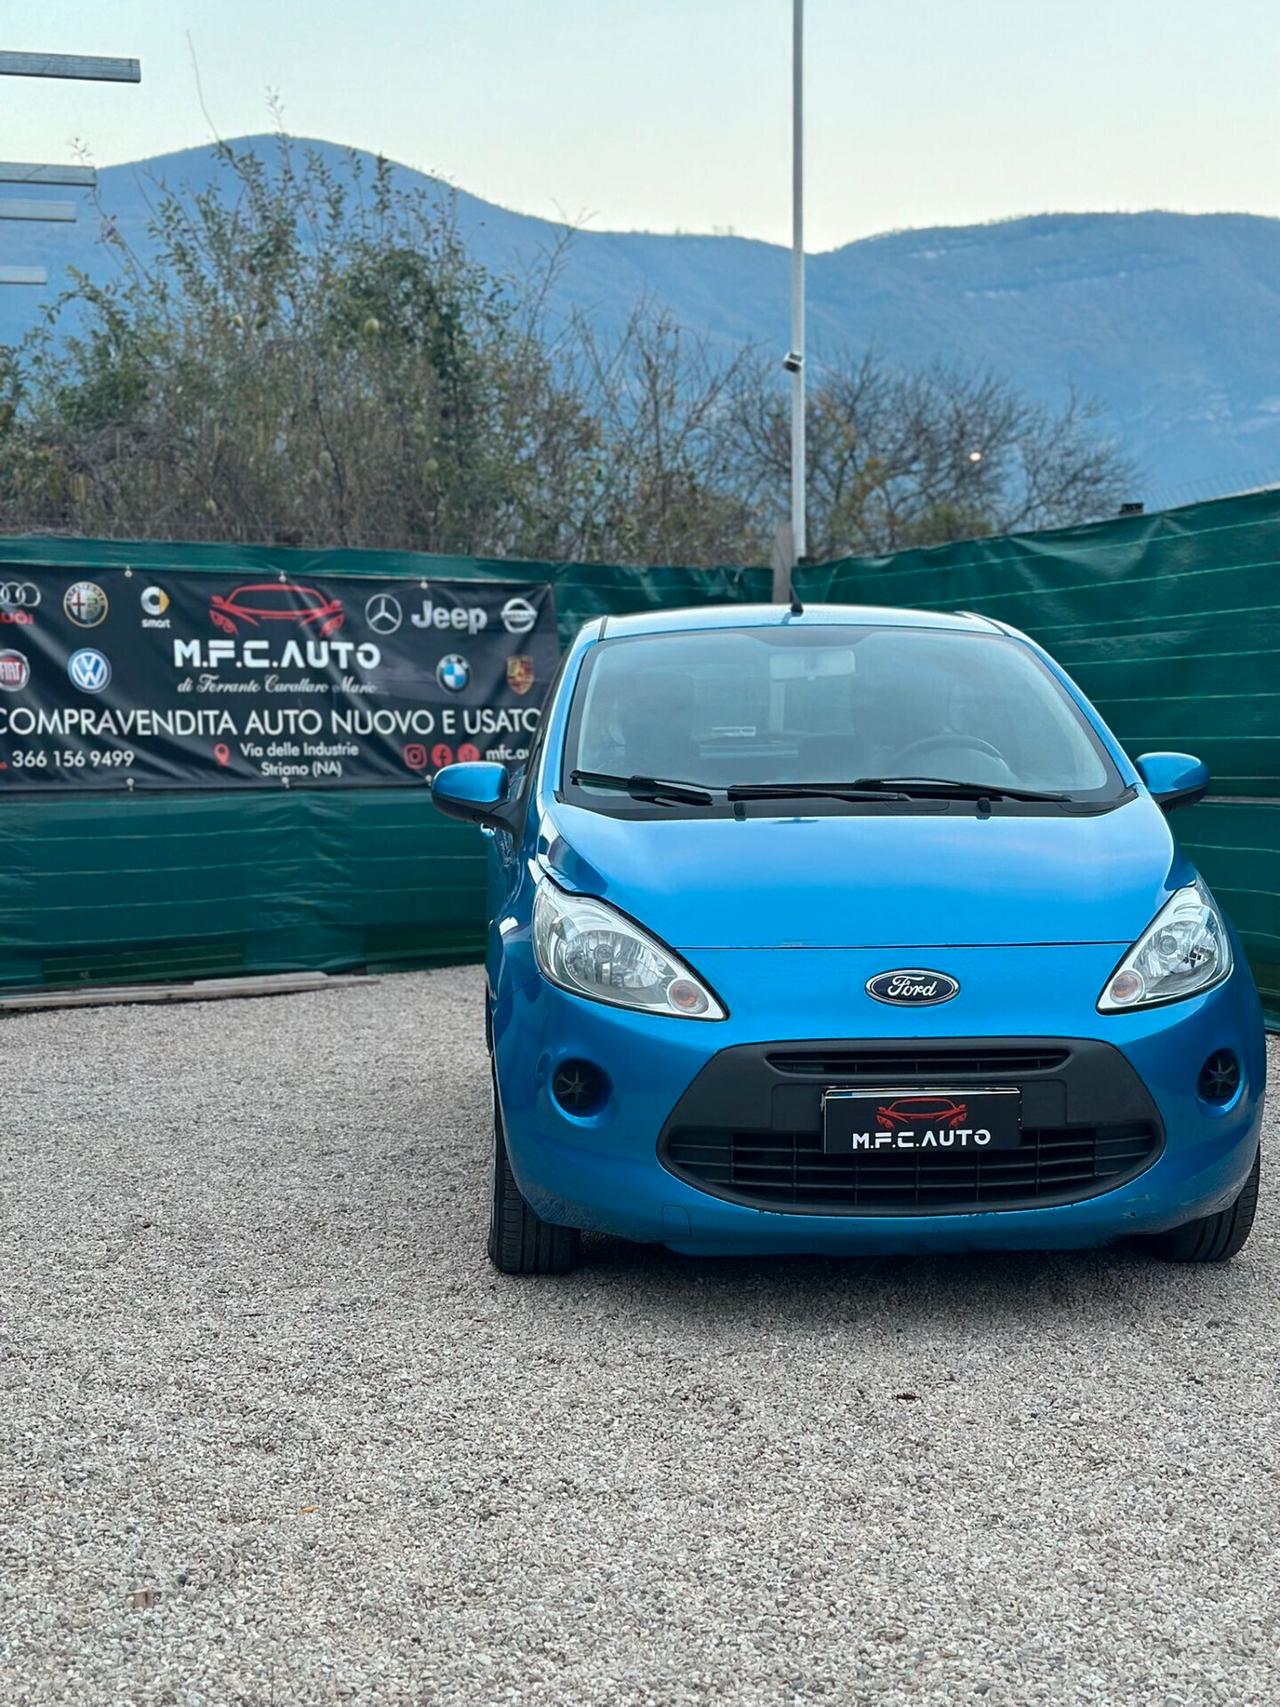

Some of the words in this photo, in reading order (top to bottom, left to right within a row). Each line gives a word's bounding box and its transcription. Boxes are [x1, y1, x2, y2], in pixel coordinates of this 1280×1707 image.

[411, 600, 488, 635] Jeep
[173, 639, 381, 670] M.F.C.AUTO
[177, 676, 193, 693] di
[244, 708, 323, 736] AUTO
[331, 709, 435, 735] NUOVO
[441, 710, 456, 734] E
[12, 750, 48, 768] 366
[53, 750, 86, 768] 156
[90, 750, 135, 767] 9499
[240, 742, 263, 757] Via
[267, 742, 300, 757] delle
[303, 741, 359, 757] Industrie
[261, 762, 308, 777] Striano
[312, 761, 342, 777] (NA)
[887, 975, 937, 997] Ford
[852, 1129, 991, 1150] M.F.C.AUTO
